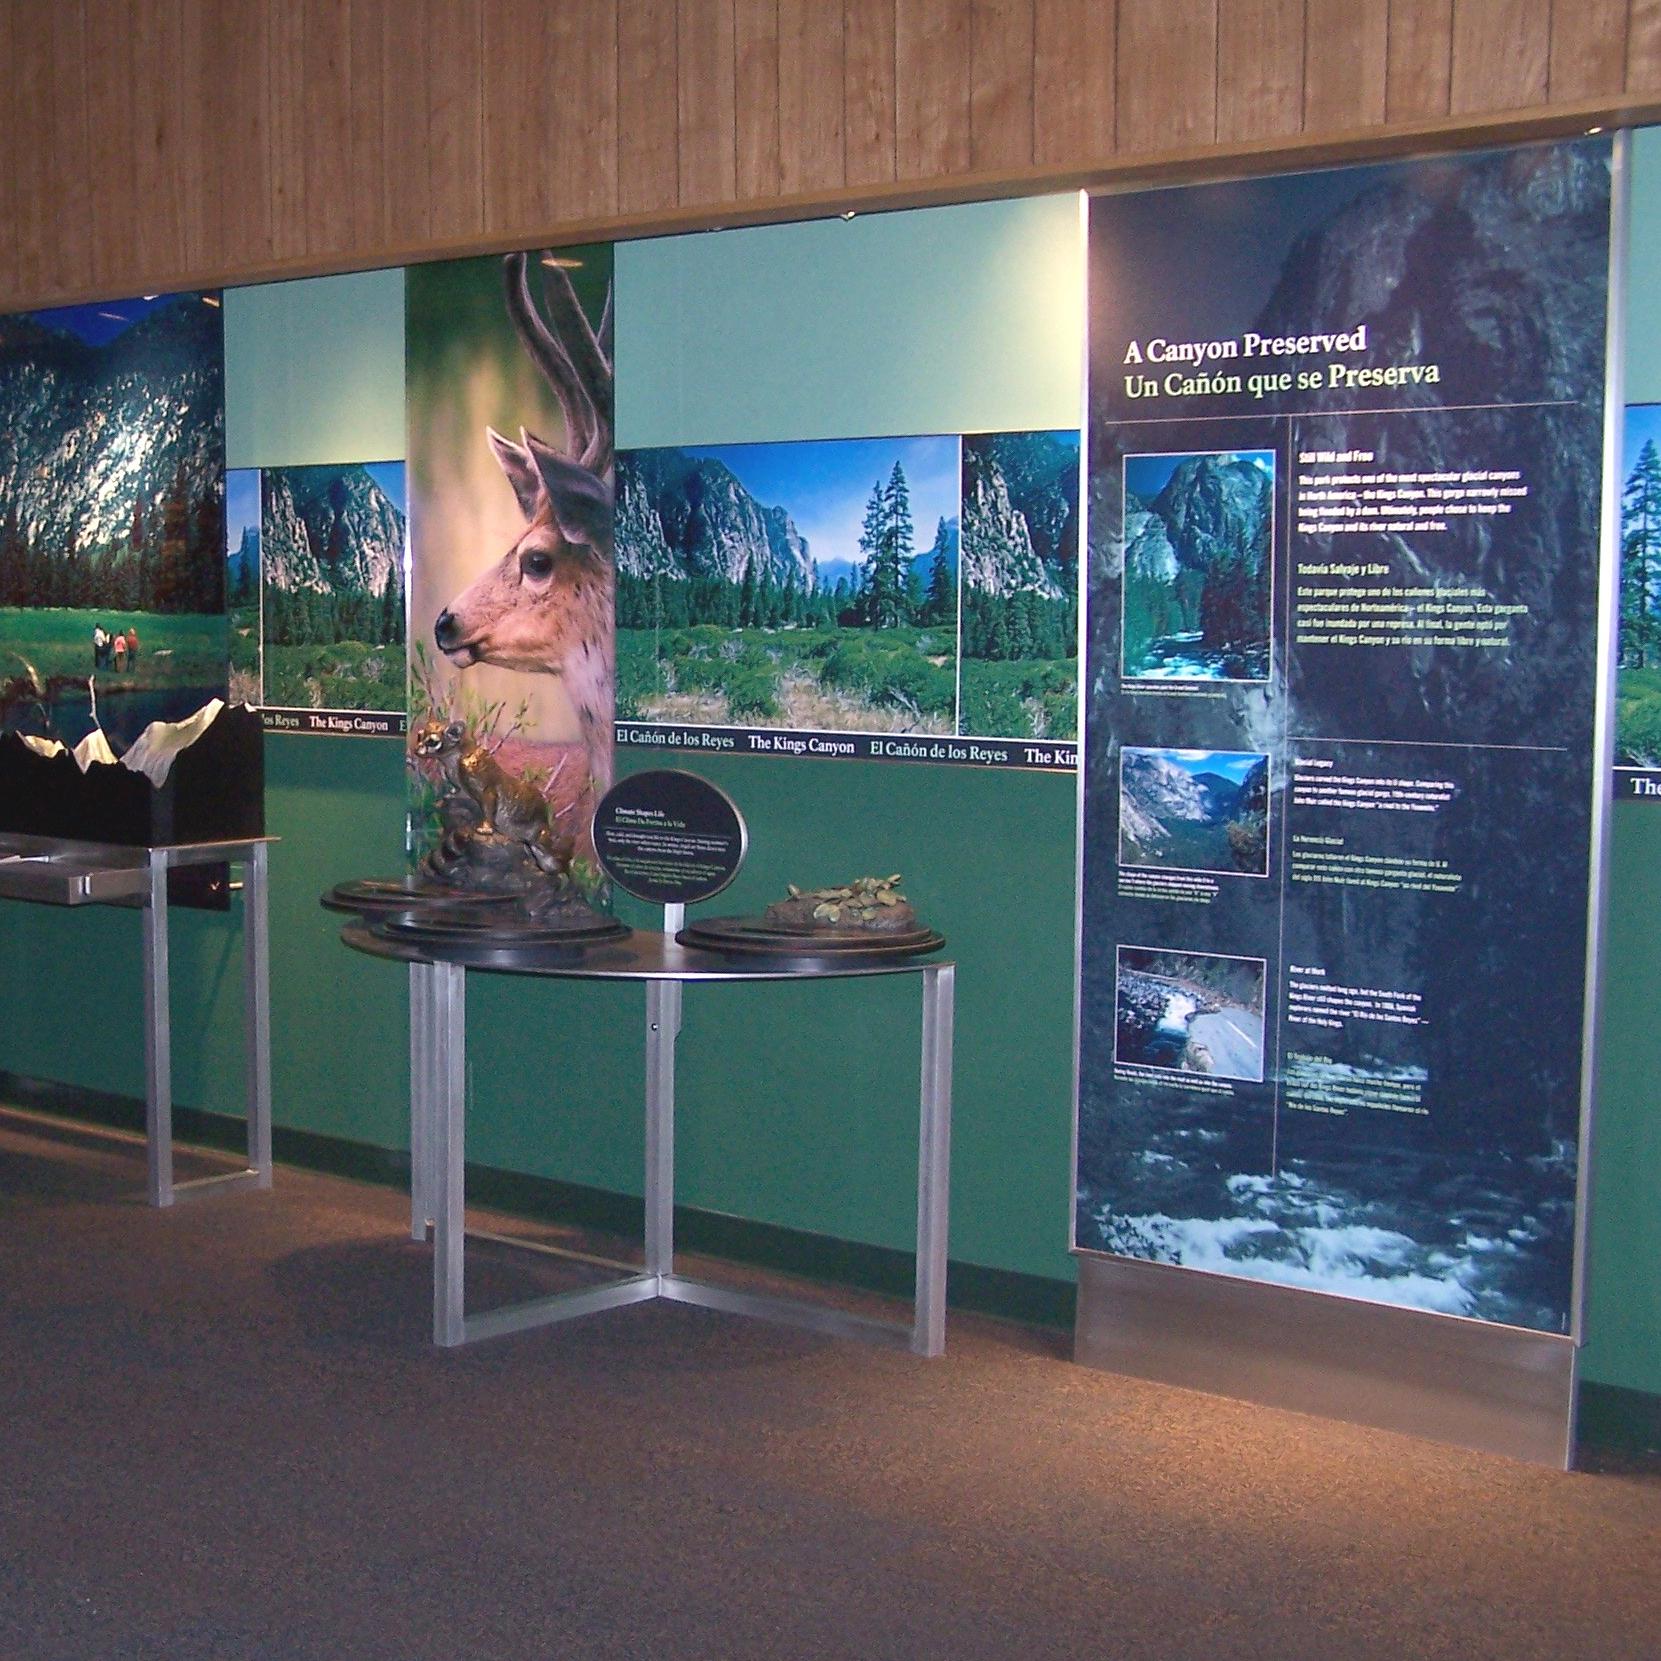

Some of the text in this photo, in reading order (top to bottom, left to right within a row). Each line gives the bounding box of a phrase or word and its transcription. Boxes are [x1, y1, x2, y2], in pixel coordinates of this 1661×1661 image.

[1123, 325, 1367, 367] A Canyon Preserved
[1124, 364, 1440, 398] Un Cañón que se Preserva
[275, 714, 300, 729] Reyes
[309, 715, 327, 729] The
[328, 717, 353, 732] Kings
[355, 718, 389, 734] Canyon
[616, 729, 735, 750] El Cañón de los Reyes
[748, 735, 855, 756] The Kings Canyon
[870, 740, 1009, 765] El Cañón de los Reyes
[1023, 748, 1078, 766] The Kin
